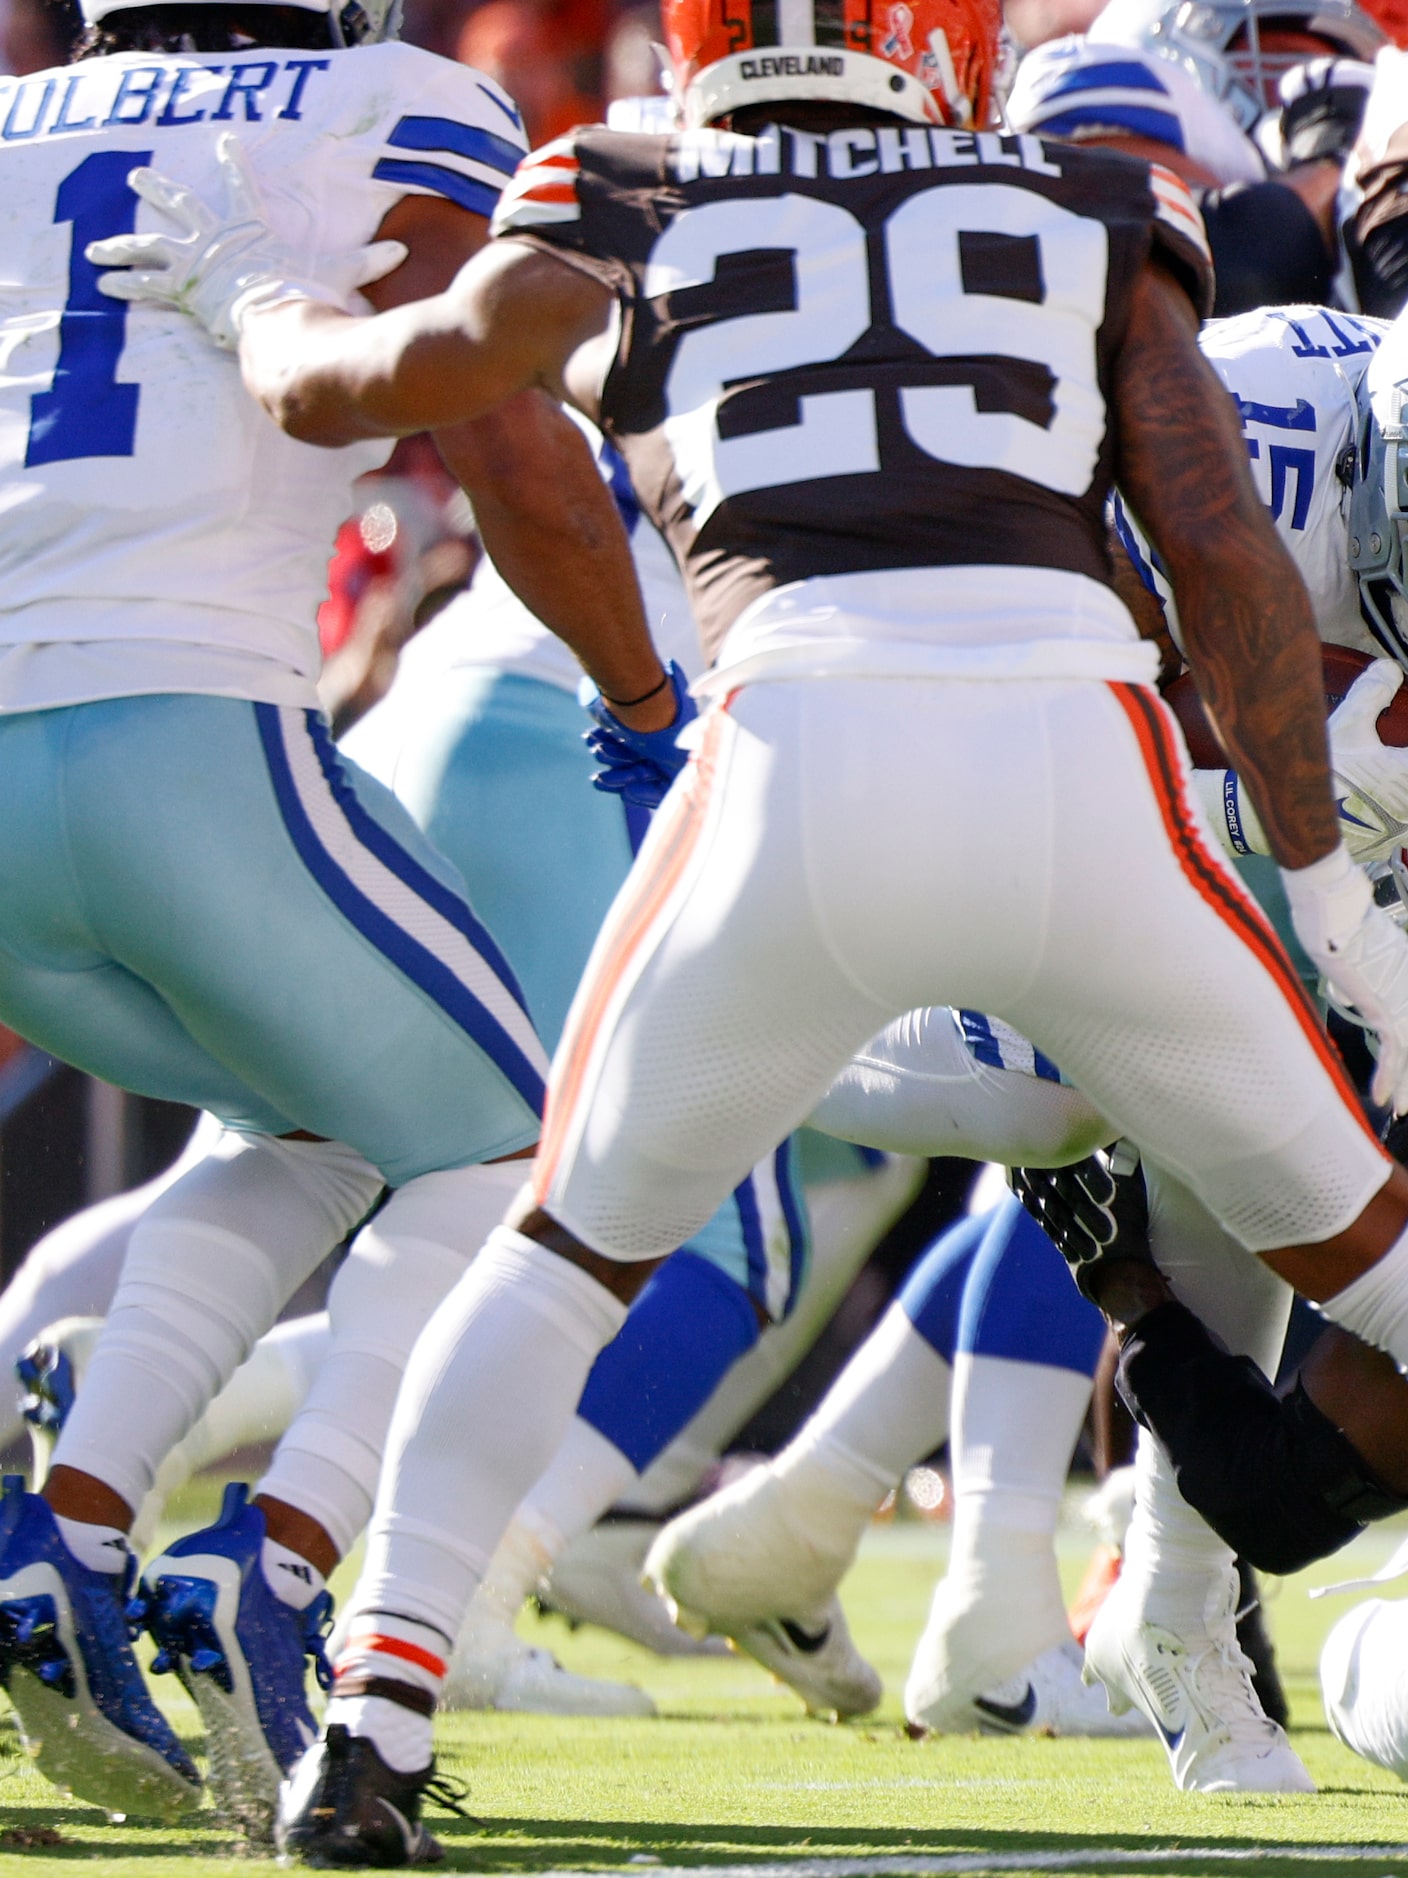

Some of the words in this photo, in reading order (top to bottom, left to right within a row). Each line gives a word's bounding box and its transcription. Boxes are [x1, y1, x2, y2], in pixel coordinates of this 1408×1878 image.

[0, 59, 331, 141] OLBERT
[740, 55, 845, 81] CLEVELAND
[676, 123, 1062, 184] MITCHELL
[26, 150, 153, 467] 1
[644, 182, 1109, 498] 29
[1233, 392, 1317, 531] 15
[1225, 781, 1234, 797] LIL
[1226, 800, 1240, 837] COREY
